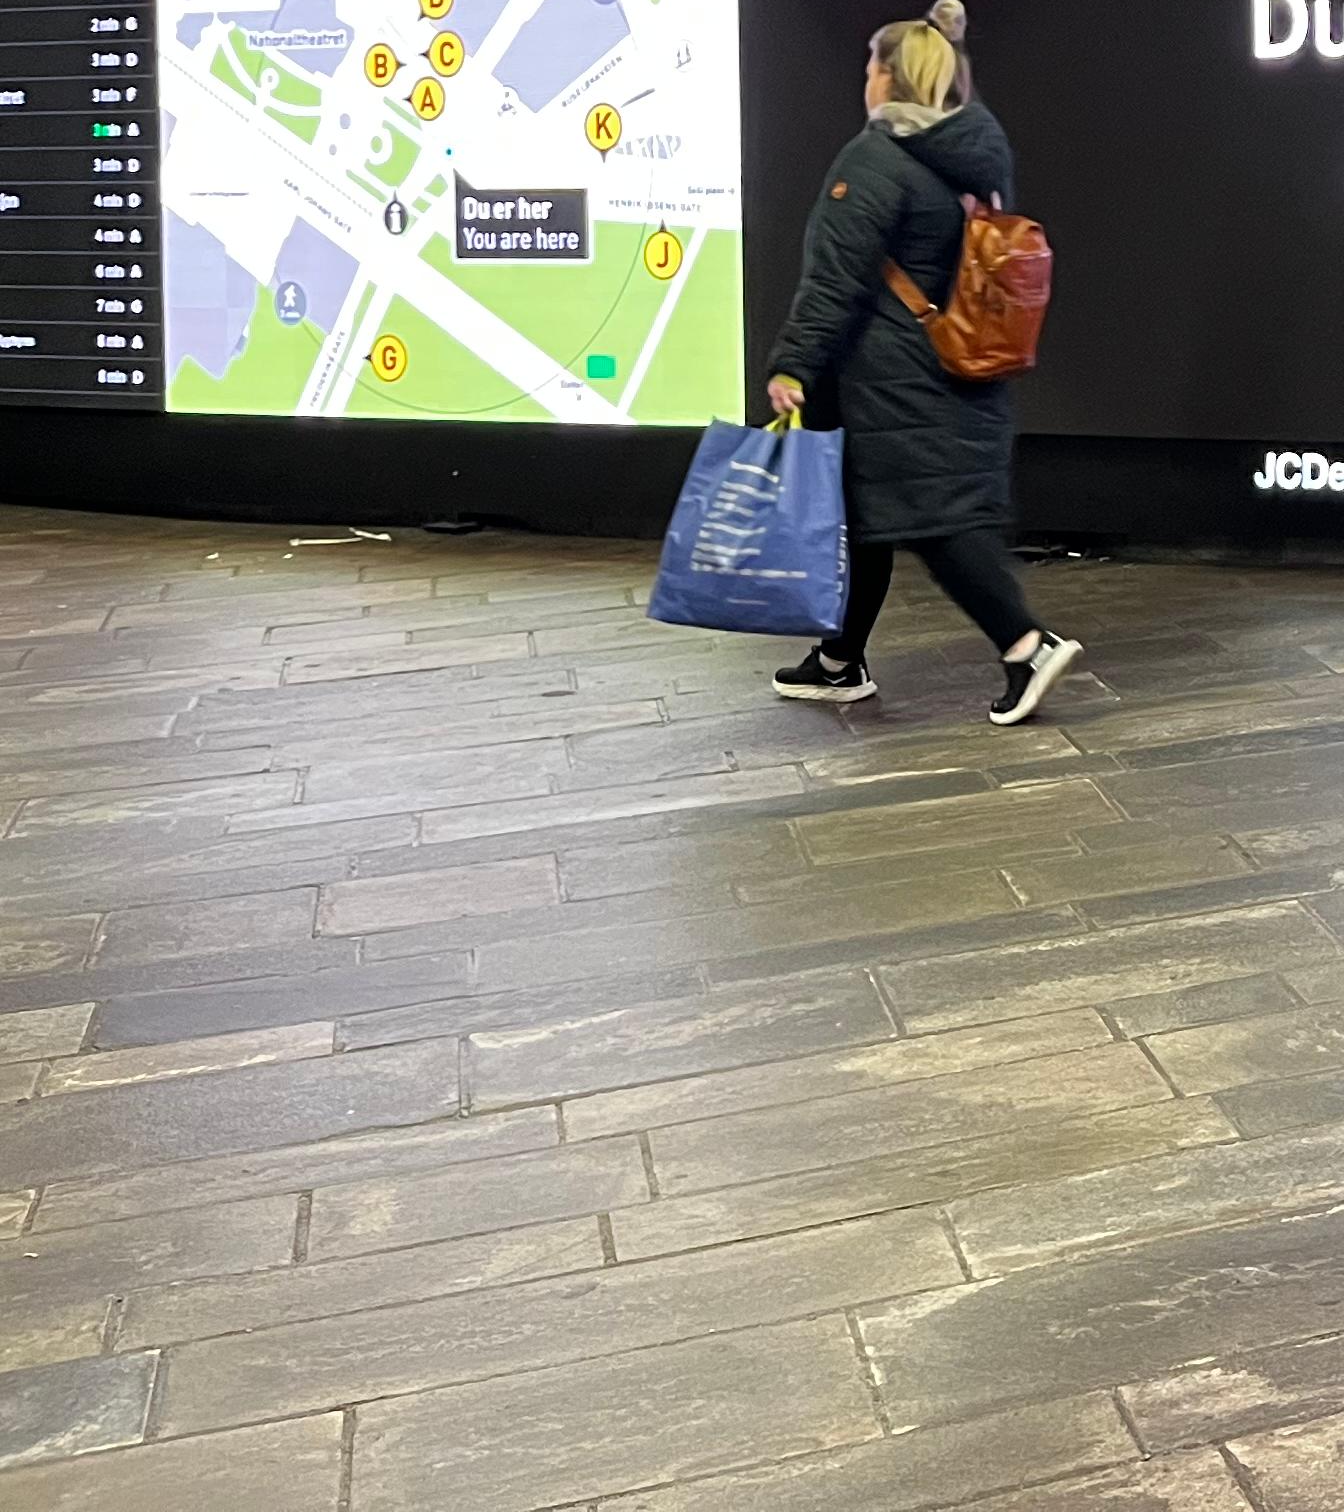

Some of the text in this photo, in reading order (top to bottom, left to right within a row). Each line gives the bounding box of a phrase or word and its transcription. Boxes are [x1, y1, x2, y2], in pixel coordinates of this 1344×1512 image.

[375, 53, 388, 79] B
[440, 41, 455, 67] C
[420, 87, 436, 113] A
[595, 112, 613, 139] K
[463, 196, 552, 220] Du er her
[463, 227, 579, 250] You are here
[656, 241, 669, 269] J
[383, 346, 397, 371] G
